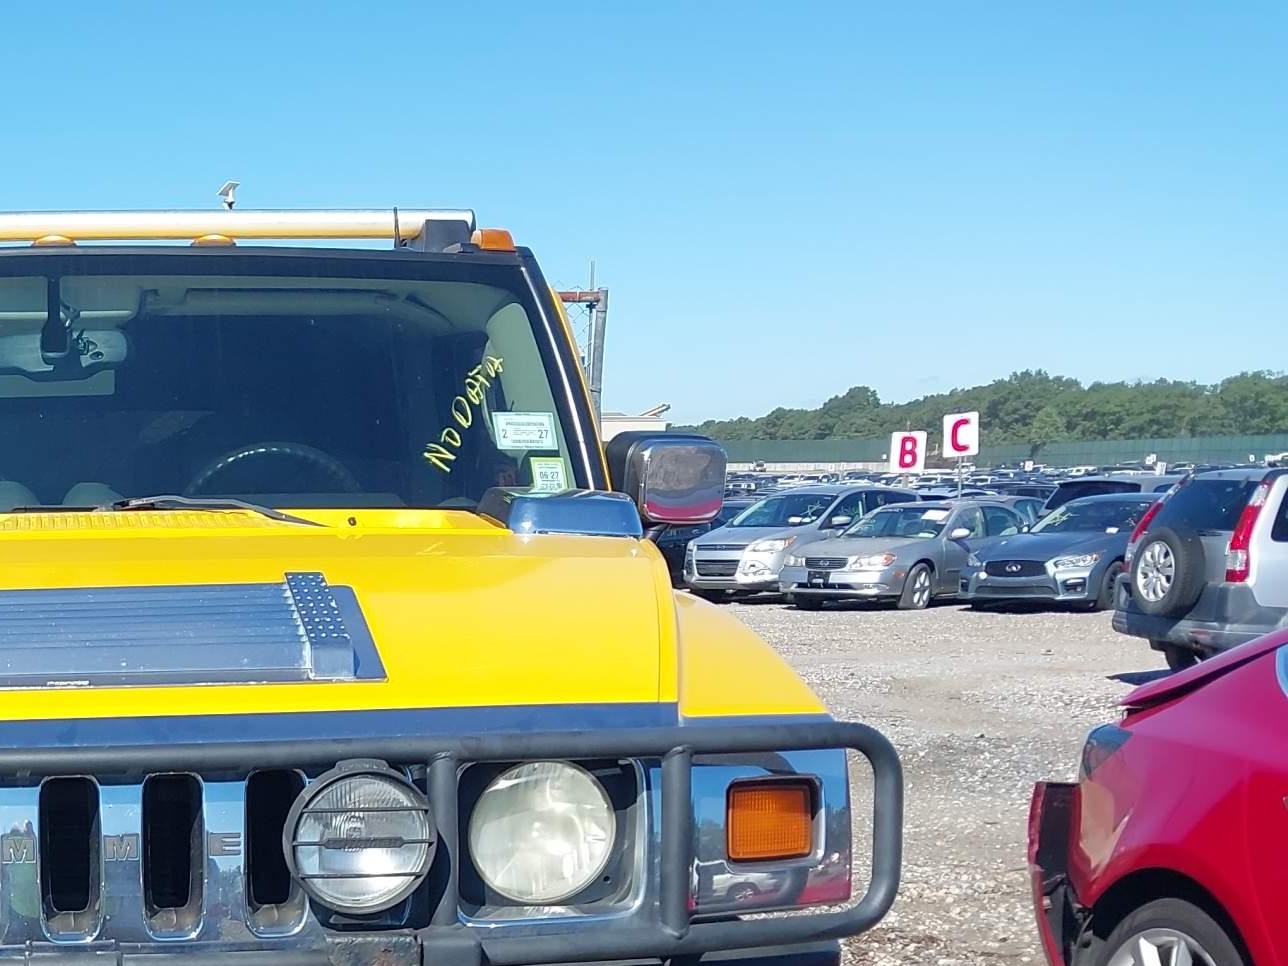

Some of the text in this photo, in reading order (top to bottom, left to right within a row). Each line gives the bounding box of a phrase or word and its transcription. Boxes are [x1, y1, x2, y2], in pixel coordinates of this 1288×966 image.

[537, 429, 549, 439] 27
[951, 418, 970, 452] C
[899, 436, 918, 468] B
